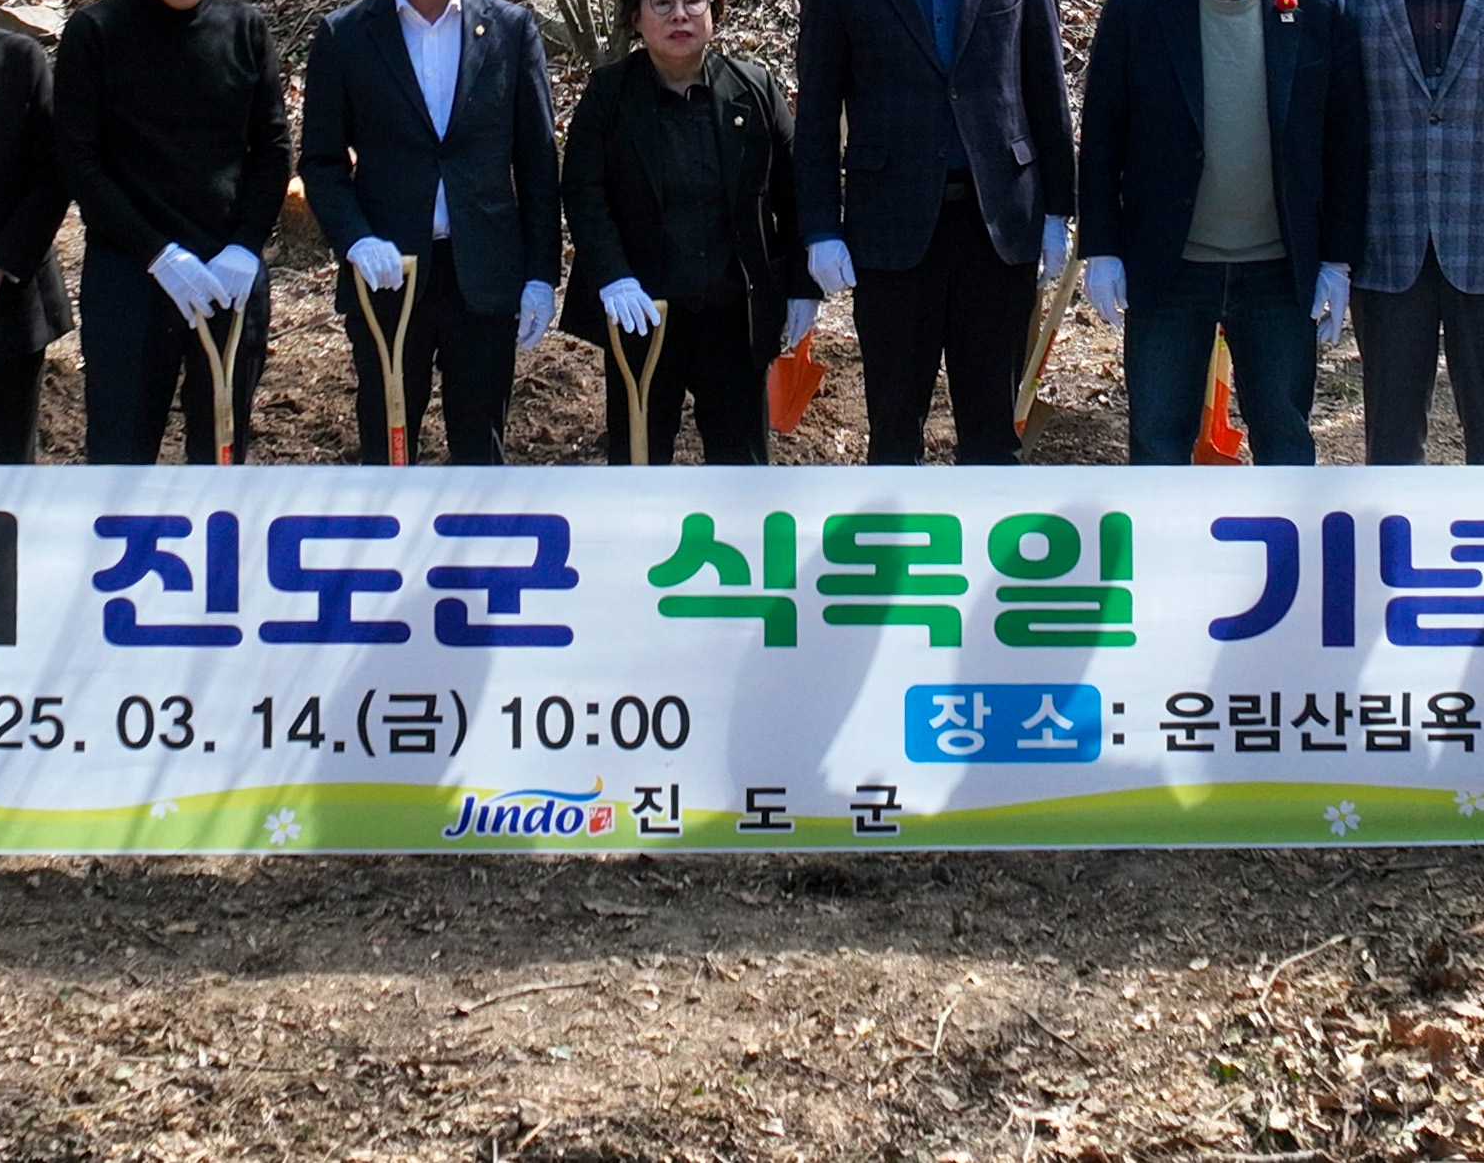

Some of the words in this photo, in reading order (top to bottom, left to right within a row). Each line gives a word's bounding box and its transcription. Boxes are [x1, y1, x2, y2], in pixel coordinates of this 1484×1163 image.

[91, 510, 579, 648] 진도군
[646, 510, 1138, 649] 식목일
[116, 695, 216, 752] 03.
[501, 694, 691, 751] 10:00
[444, 796, 585, 837] Jindo
